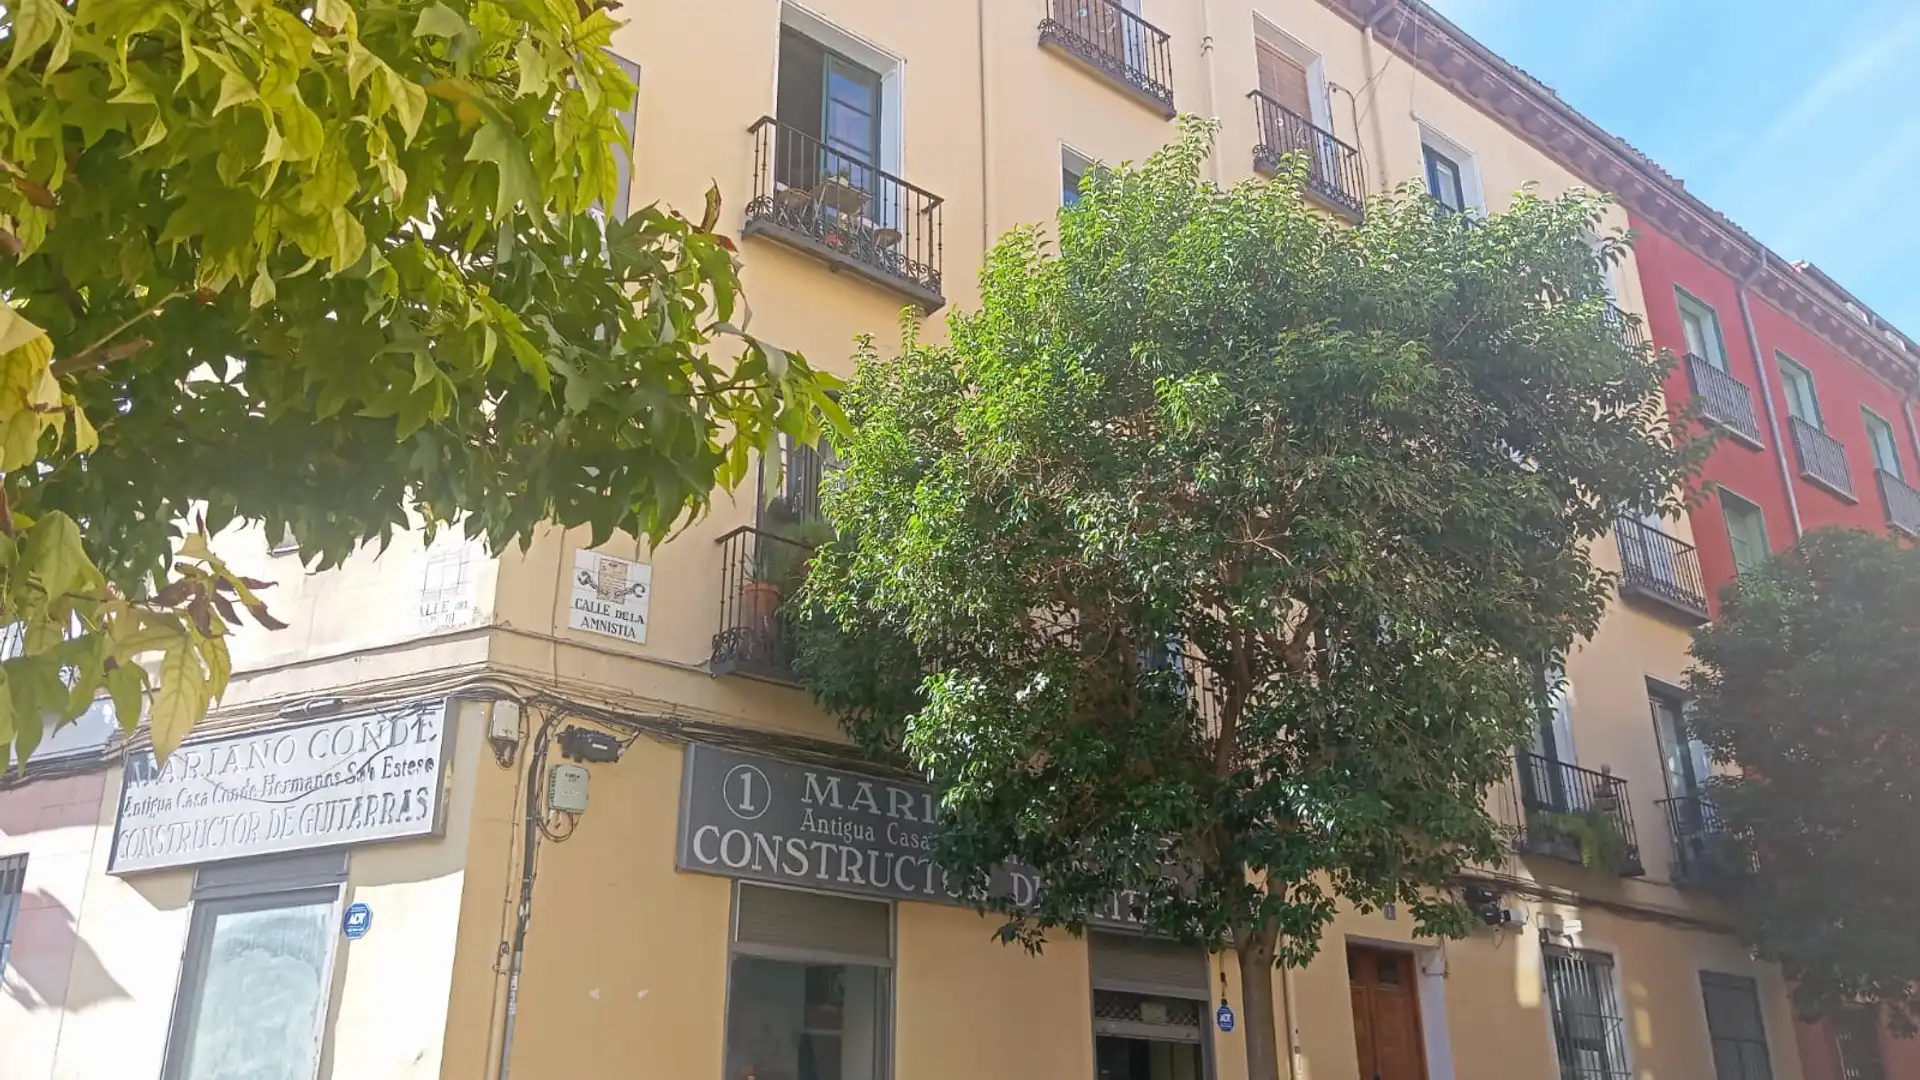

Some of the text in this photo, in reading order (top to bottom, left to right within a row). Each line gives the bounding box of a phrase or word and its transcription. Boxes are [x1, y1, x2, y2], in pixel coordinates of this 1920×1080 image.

[575, 598, 610, 617] CALLE
[580, 616, 636, 639] AMNISTIA
[127, 711, 438, 788] MARIANO CONDE
[122, 796, 172, 819] Antigua
[176, 788, 208, 808] Casa
[212, 778, 256, 804] Conde
[739, 771, 755, 812] 1
[801, 771, 945, 826] MARI
[117, 786, 428, 859] CONSTRUCTOR DE GUITARRAS
[800, 808, 931, 851] Antigua Casa
